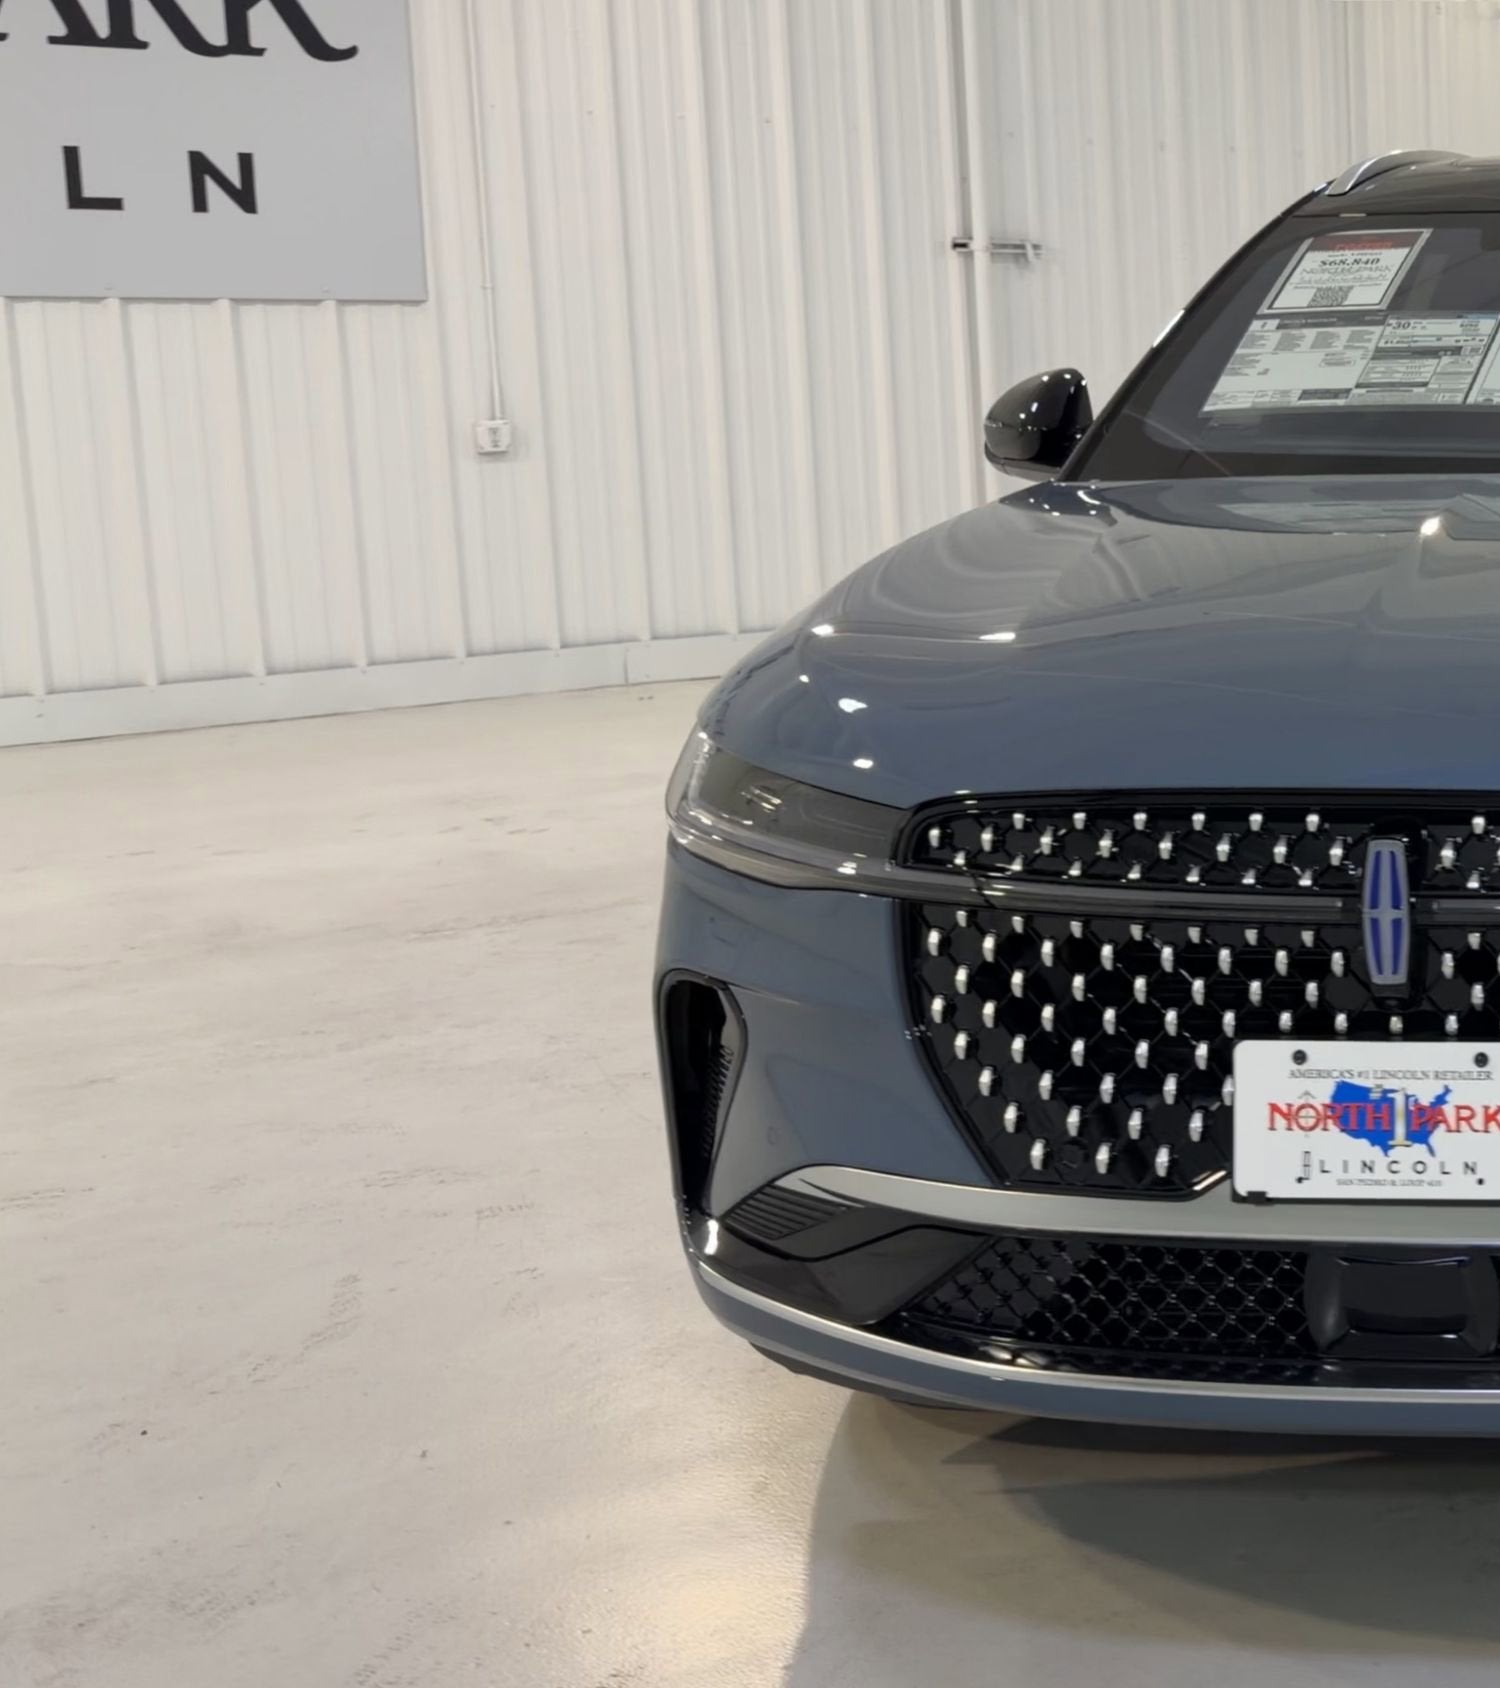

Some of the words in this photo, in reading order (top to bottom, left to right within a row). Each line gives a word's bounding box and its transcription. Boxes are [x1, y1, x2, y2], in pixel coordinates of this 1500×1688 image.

[1372, 1069, 1430, 1080] LINCOLN
[1432, 1070, 1495, 1081] RETAILER
[1267, 1102, 1391, 1133] NORTH
[1319, 1159, 1478, 1176] LINCOLN
